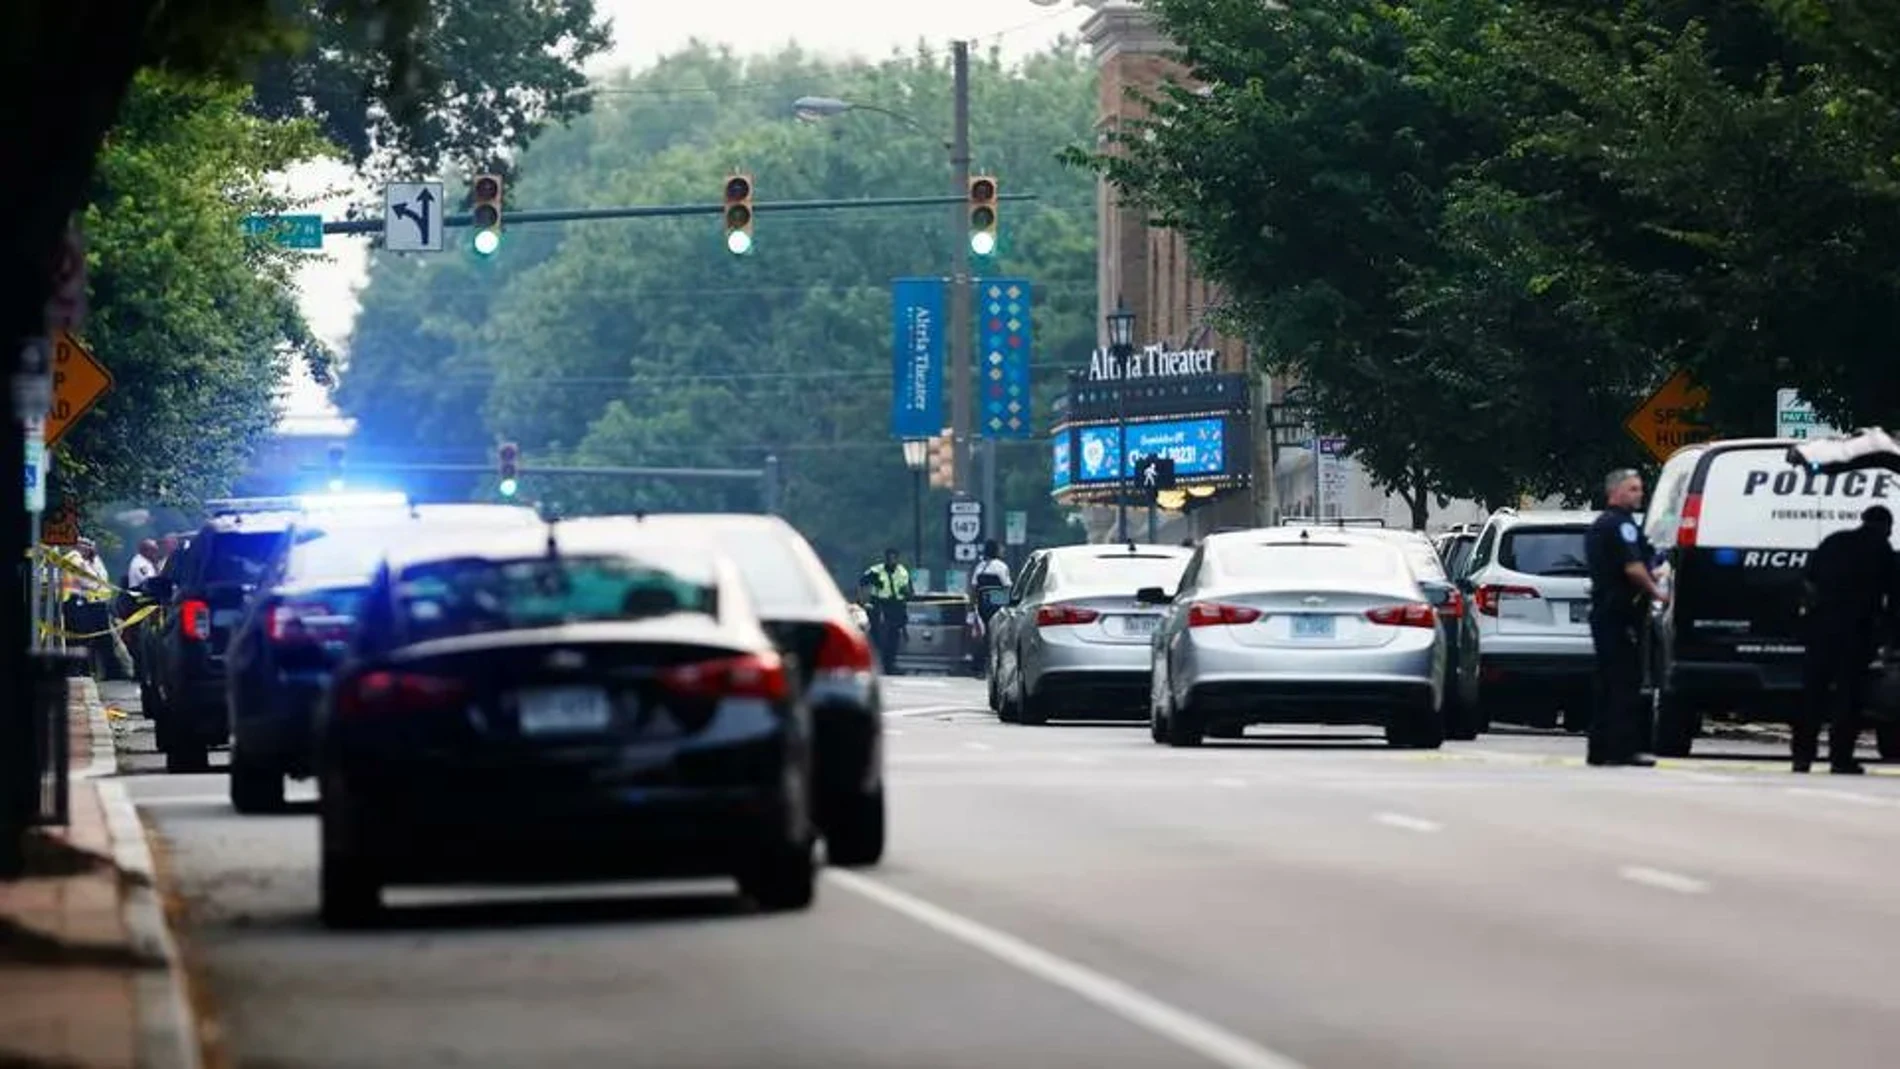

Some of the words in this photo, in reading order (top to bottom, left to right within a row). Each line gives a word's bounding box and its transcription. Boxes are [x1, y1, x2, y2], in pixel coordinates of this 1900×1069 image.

[915, 306, 931, 351] Altria
[915, 353, 930, 411] Theater
[1088, 346, 1141, 382] Altia
[1144, 342, 1216, 378] Theater
[1743, 470, 1893, 498] POLICE
[1743, 552, 1809, 568] RICH
